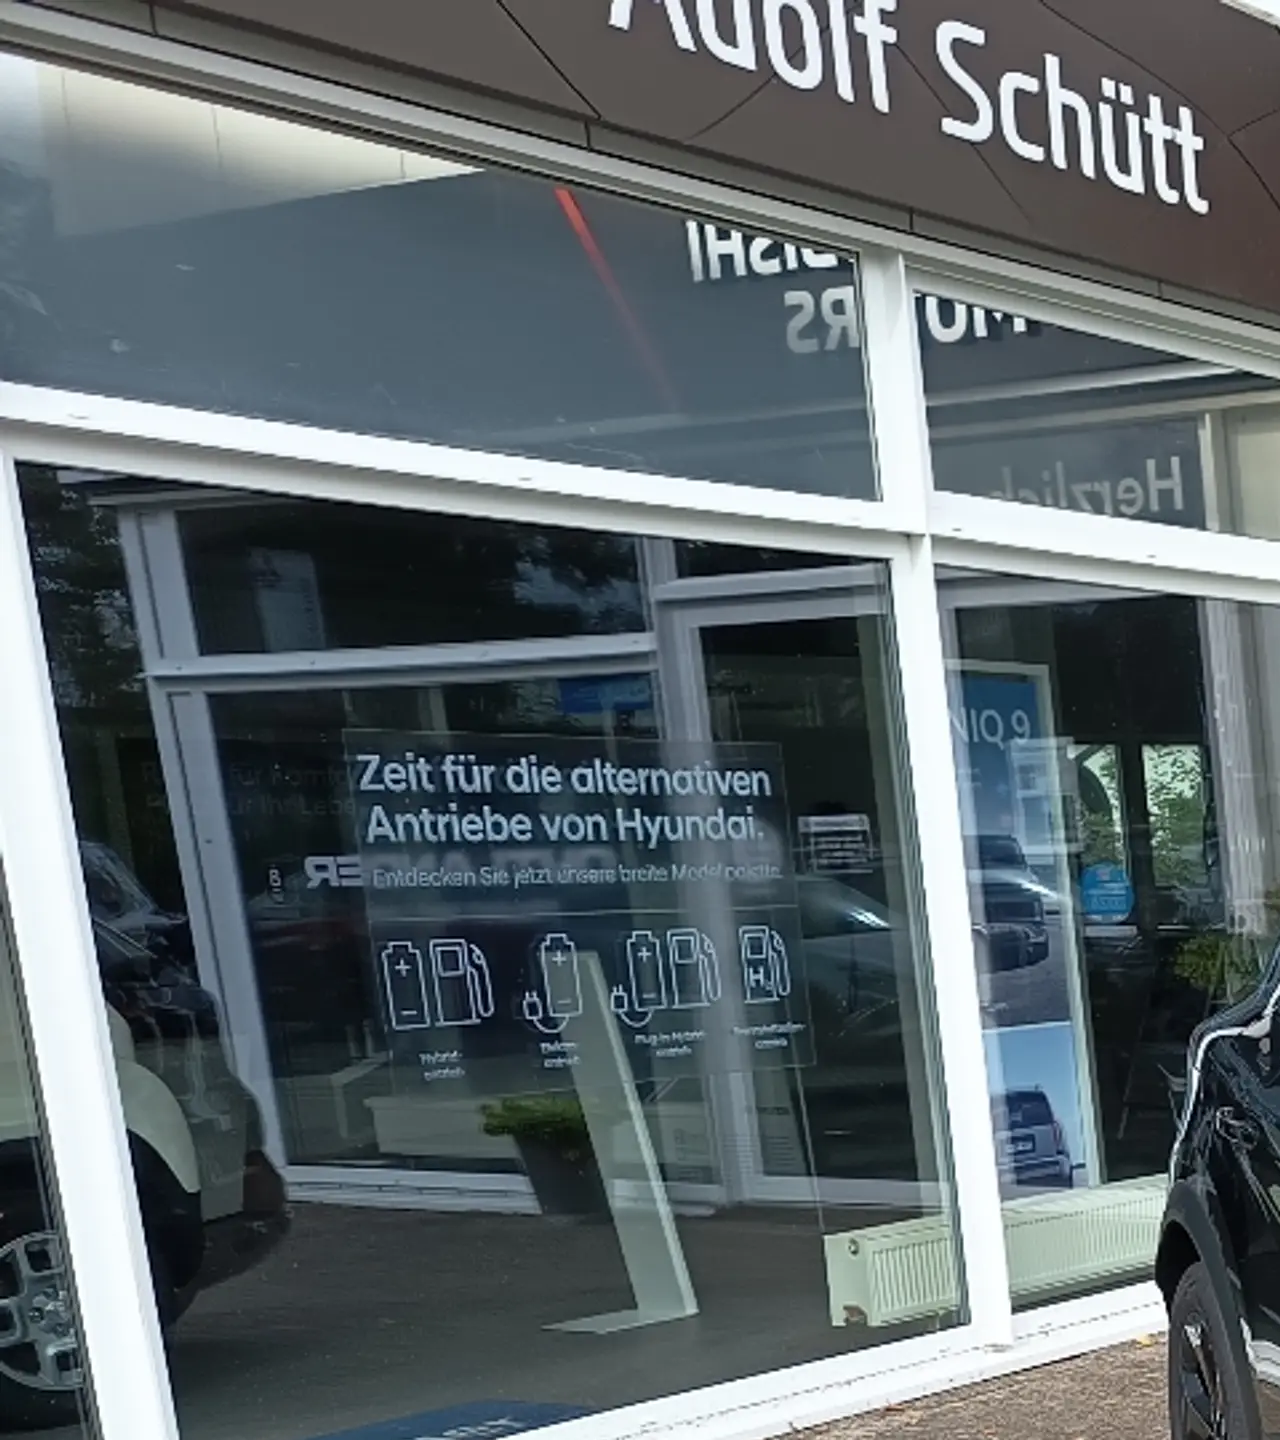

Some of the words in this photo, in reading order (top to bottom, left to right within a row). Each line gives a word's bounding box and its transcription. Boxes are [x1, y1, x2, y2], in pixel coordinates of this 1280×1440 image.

[934, 19, 1210, 215] Schütt
[1010, 708, 1031, 745] 9
[356, 752, 435, 792] Zeit
[441, 754, 496, 793] für
[505, 754, 562, 794] die
[570, 757, 773, 797] alternativen
[365, 802, 532, 844] Antriebe
[539, 812, 608, 843] von
[615, 805, 765, 850] Hyundai.
[372, 866, 477, 888] Entdecken
